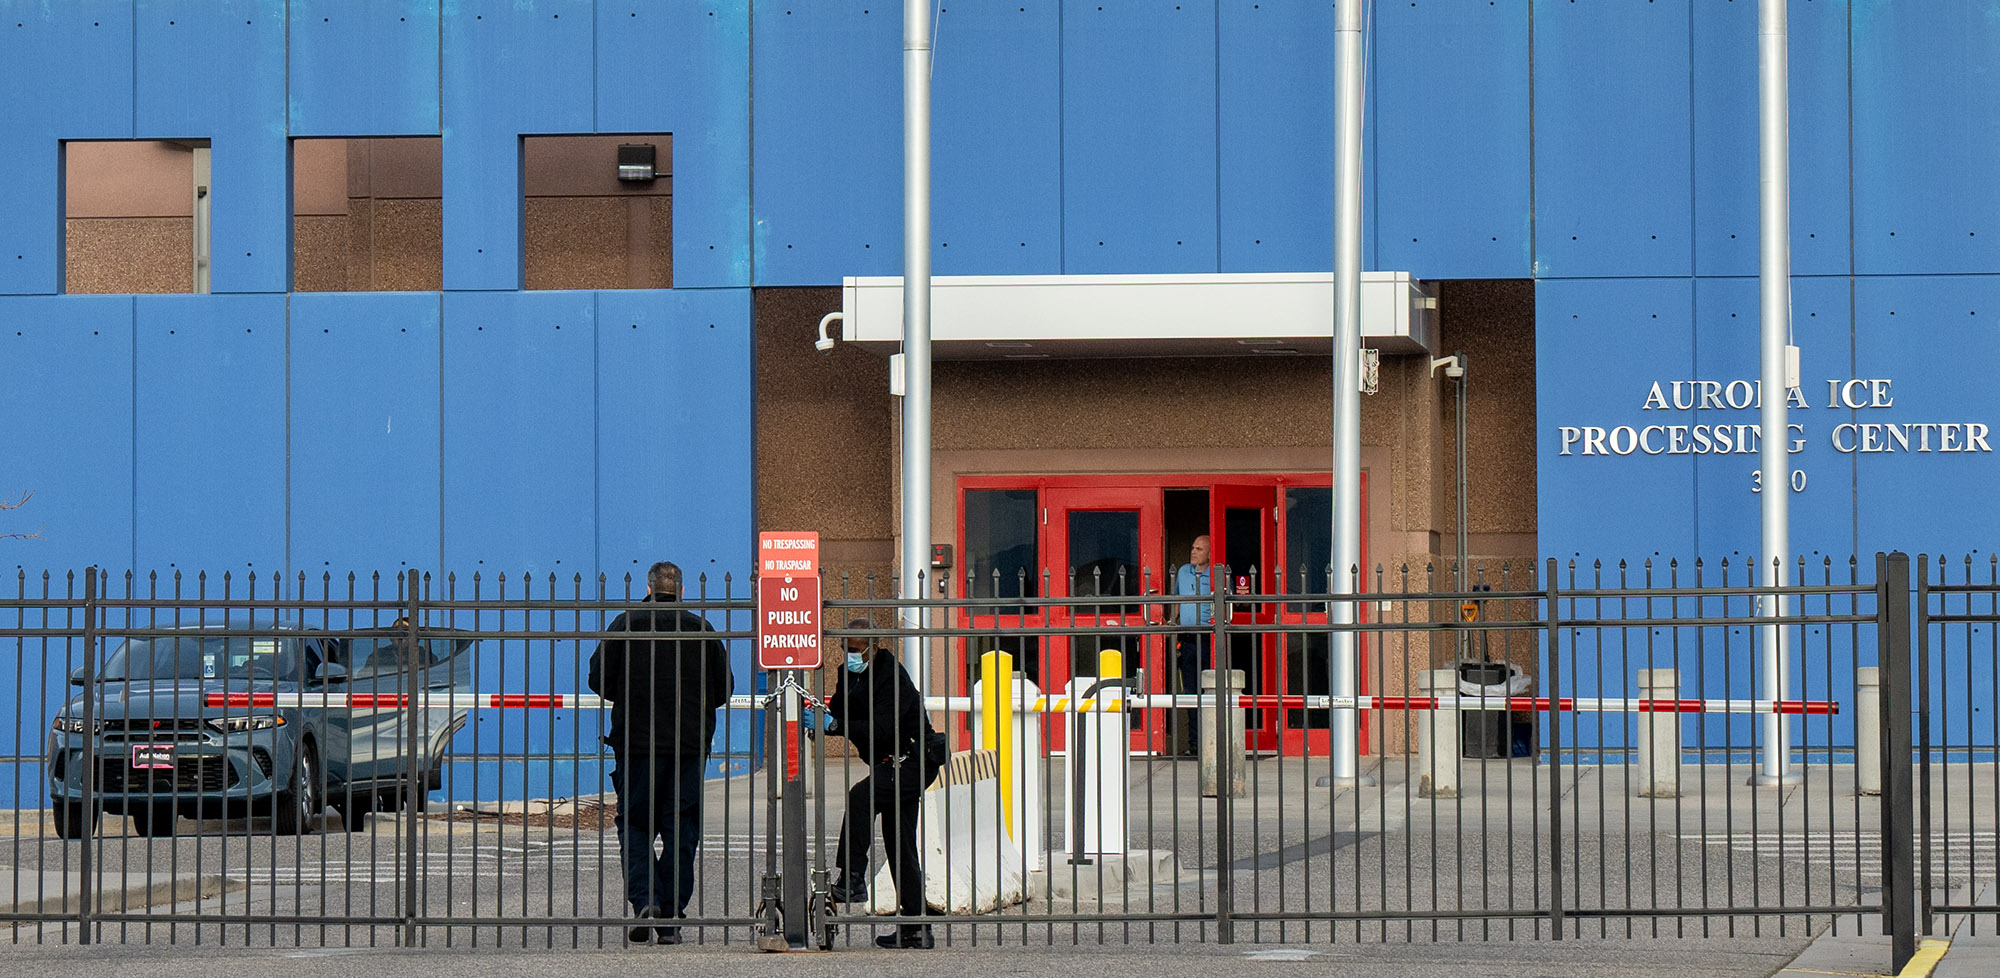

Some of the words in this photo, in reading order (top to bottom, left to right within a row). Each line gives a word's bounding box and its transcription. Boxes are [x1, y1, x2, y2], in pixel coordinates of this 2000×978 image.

[1642, 379, 1810, 410] AUROA
[1826, 379, 1894, 409] ICE
[1831, 423, 1993, 453] CENTER
[762, 539, 772, 549] NO
[773, 539, 815, 549] TRESPASSING
[765, 560, 774, 570] NO
[776, 560, 811, 570] TRASPASAR
[780, 587, 799, 601] NO
[768, 610, 812, 625] PUBLIC
[763, 634, 817, 648] PARKING
[139, 752, 170, 761] AutNation
